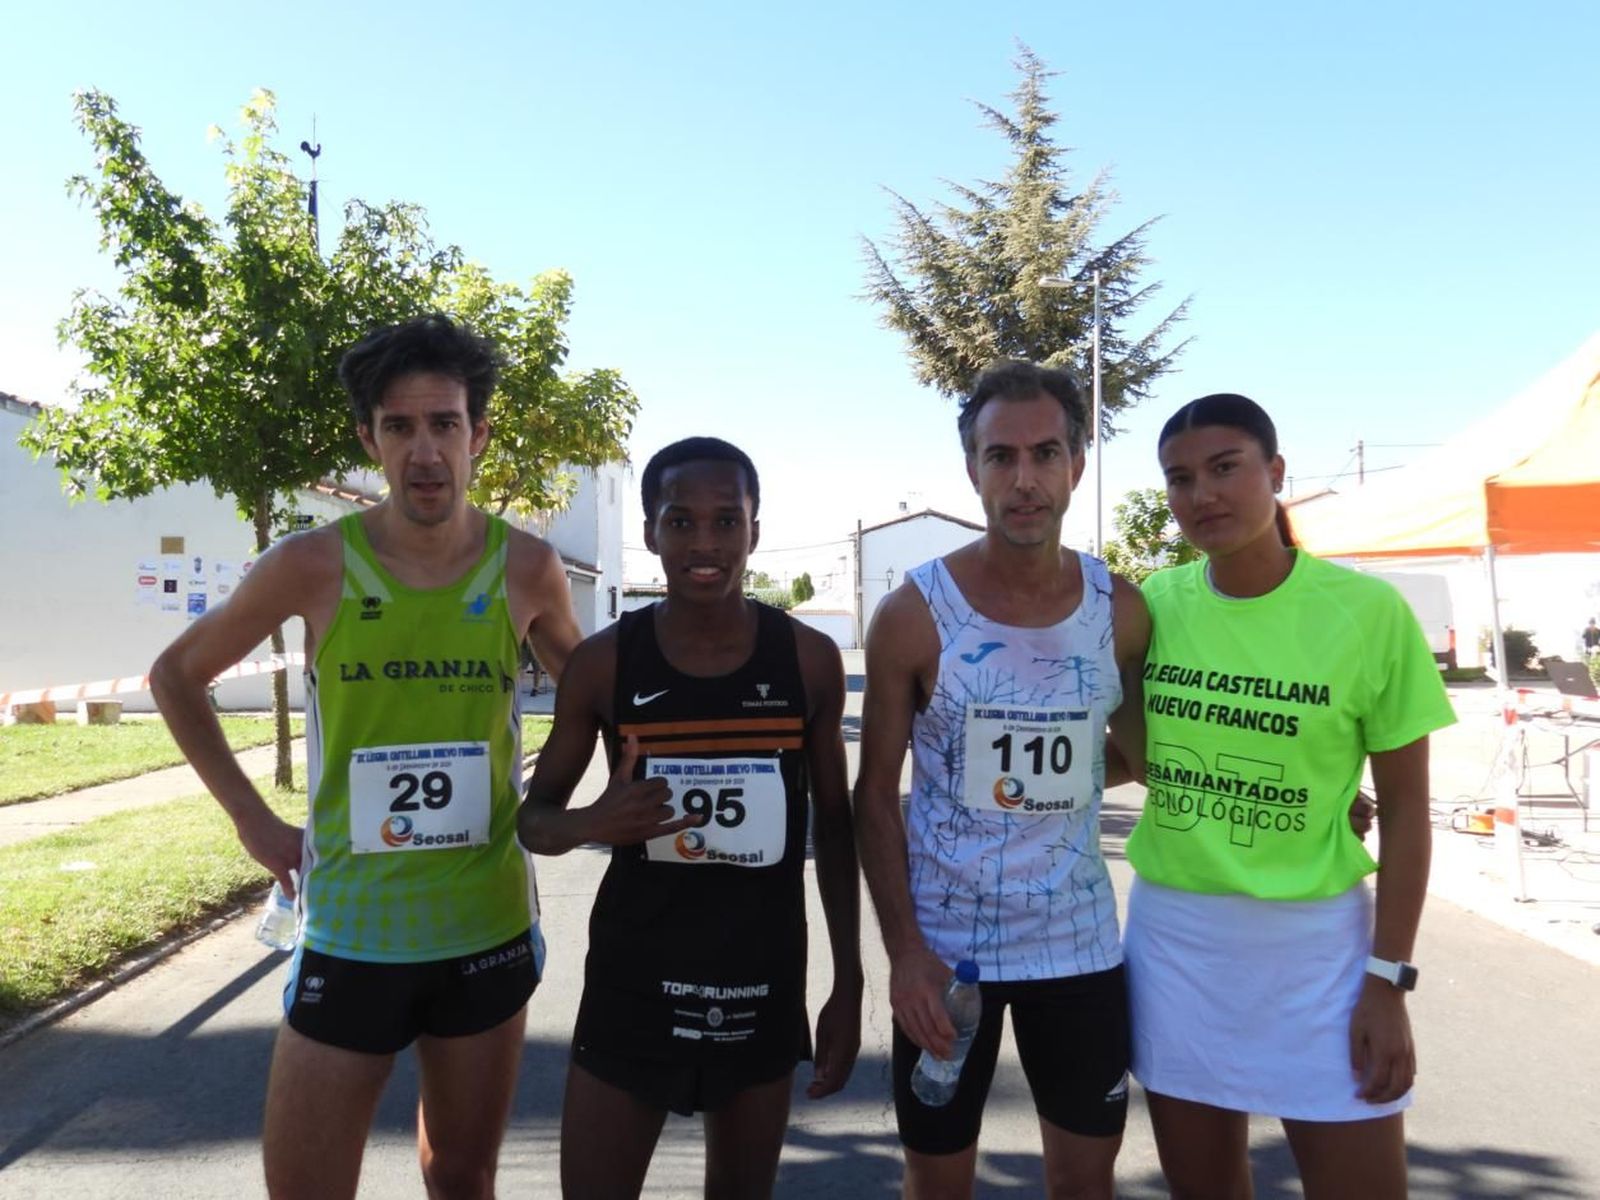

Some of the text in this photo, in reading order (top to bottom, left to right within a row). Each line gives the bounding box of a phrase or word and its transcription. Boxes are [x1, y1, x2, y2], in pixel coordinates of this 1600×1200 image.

[340, 659, 493, 682] LA GRANJA
[439, 683, 495, 693] DE CHICO
[1206, 671, 1330, 706] CASTELLANA
[1205, 703, 1299, 737] FRANCOS
[992, 733, 1072, 775] 110
[389, 770, 453, 813] 29
[682, 788, 746, 828] 95
[1023, 797, 1074, 811] Seosal
[1149, 785, 1306, 832] ECNOLÓGICOS
[413, 829, 469, 846] Seosal
[707, 849, 763, 863] Seosal
